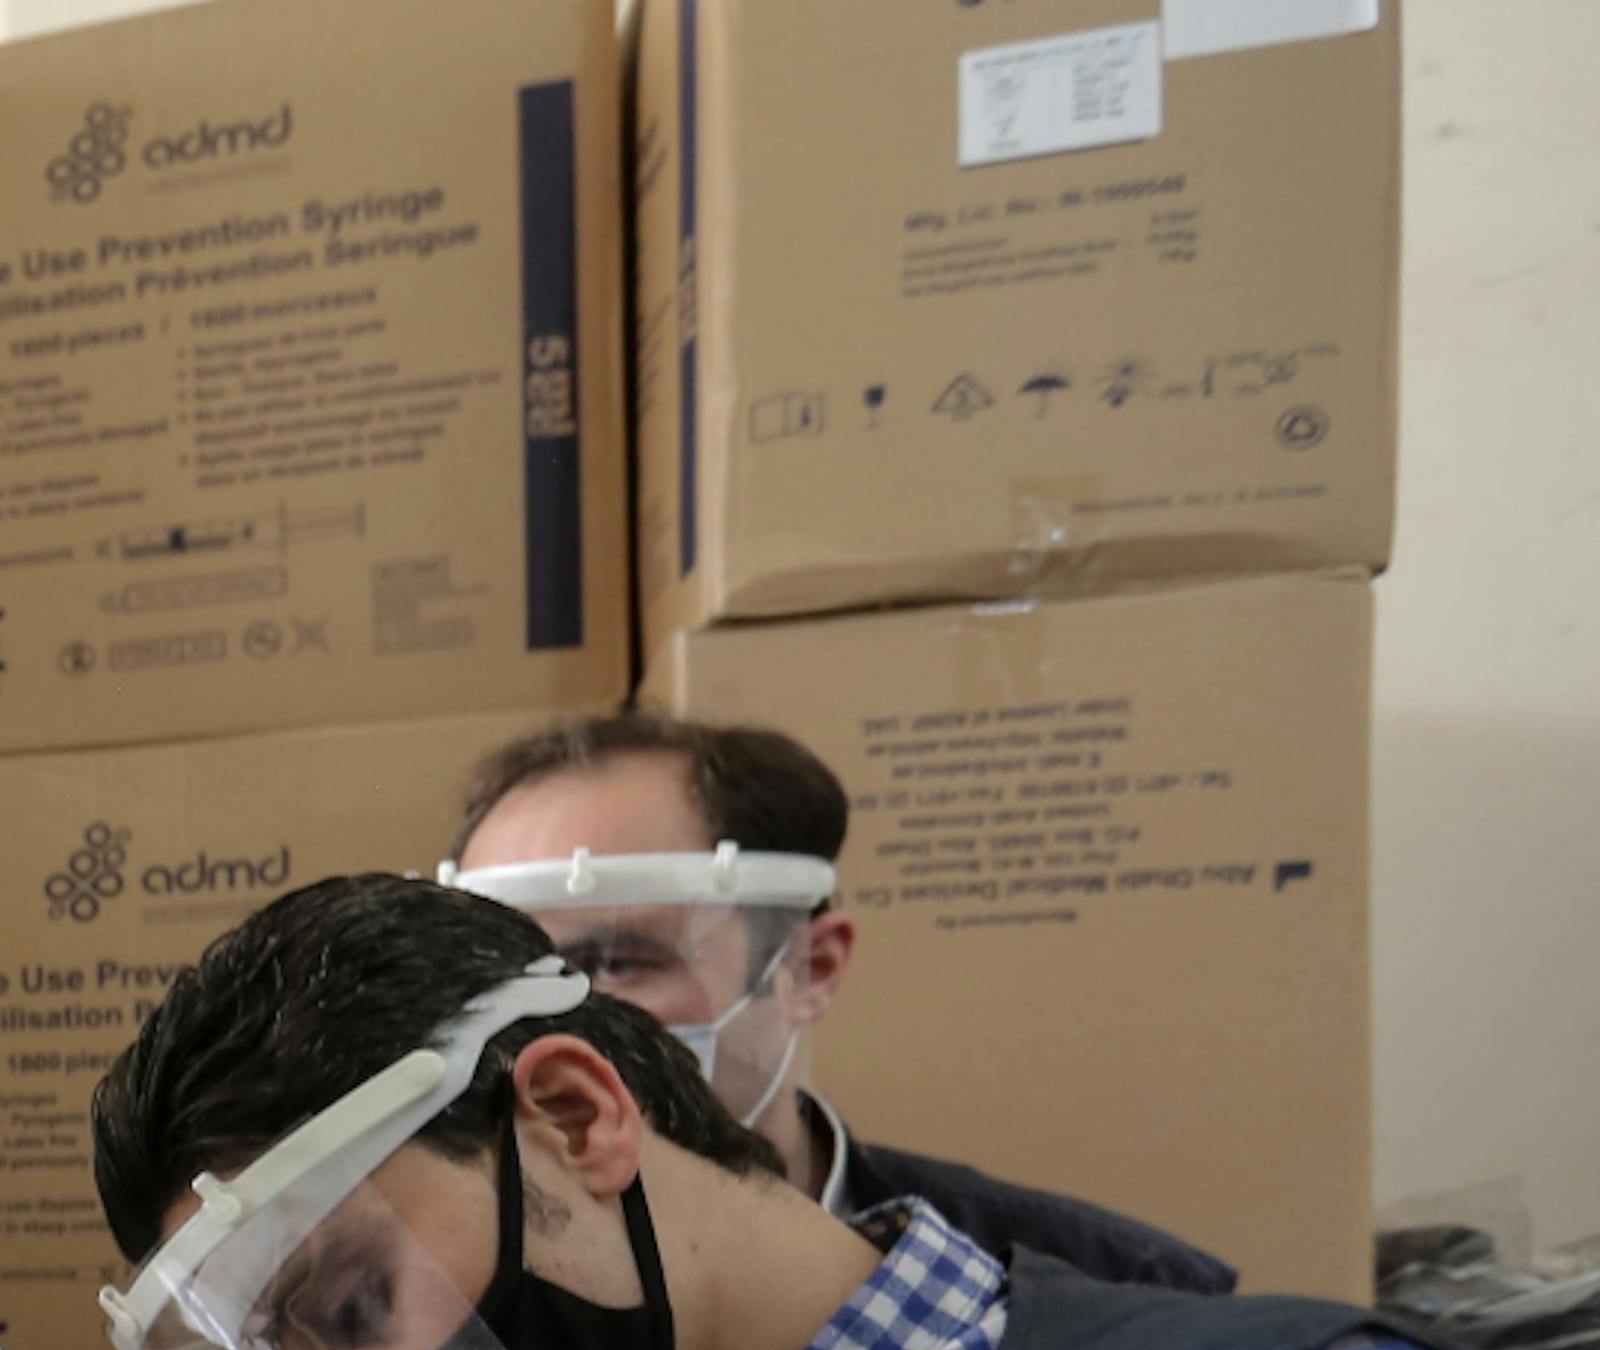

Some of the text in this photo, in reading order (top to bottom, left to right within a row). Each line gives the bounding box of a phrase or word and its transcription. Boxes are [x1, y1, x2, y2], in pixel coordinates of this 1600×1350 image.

[143, 102, 292, 169] admd
[22, 247, 88, 281] Use
[98, 212, 290, 267] Prevention
[302, 186, 445, 234] Syringe
[136, 248, 313, 298] Prévention
[325, 221, 480, 267] Seringue
[141, 846, 292, 895] admd
[1007, 875, 1107, 897] Medical
[1115, 868, 1195, 892] Dhabi
[1201, 864, 1257, 885] Abu
[901, 881, 999, 903] Devices
[20, 963, 84, 994] Use
